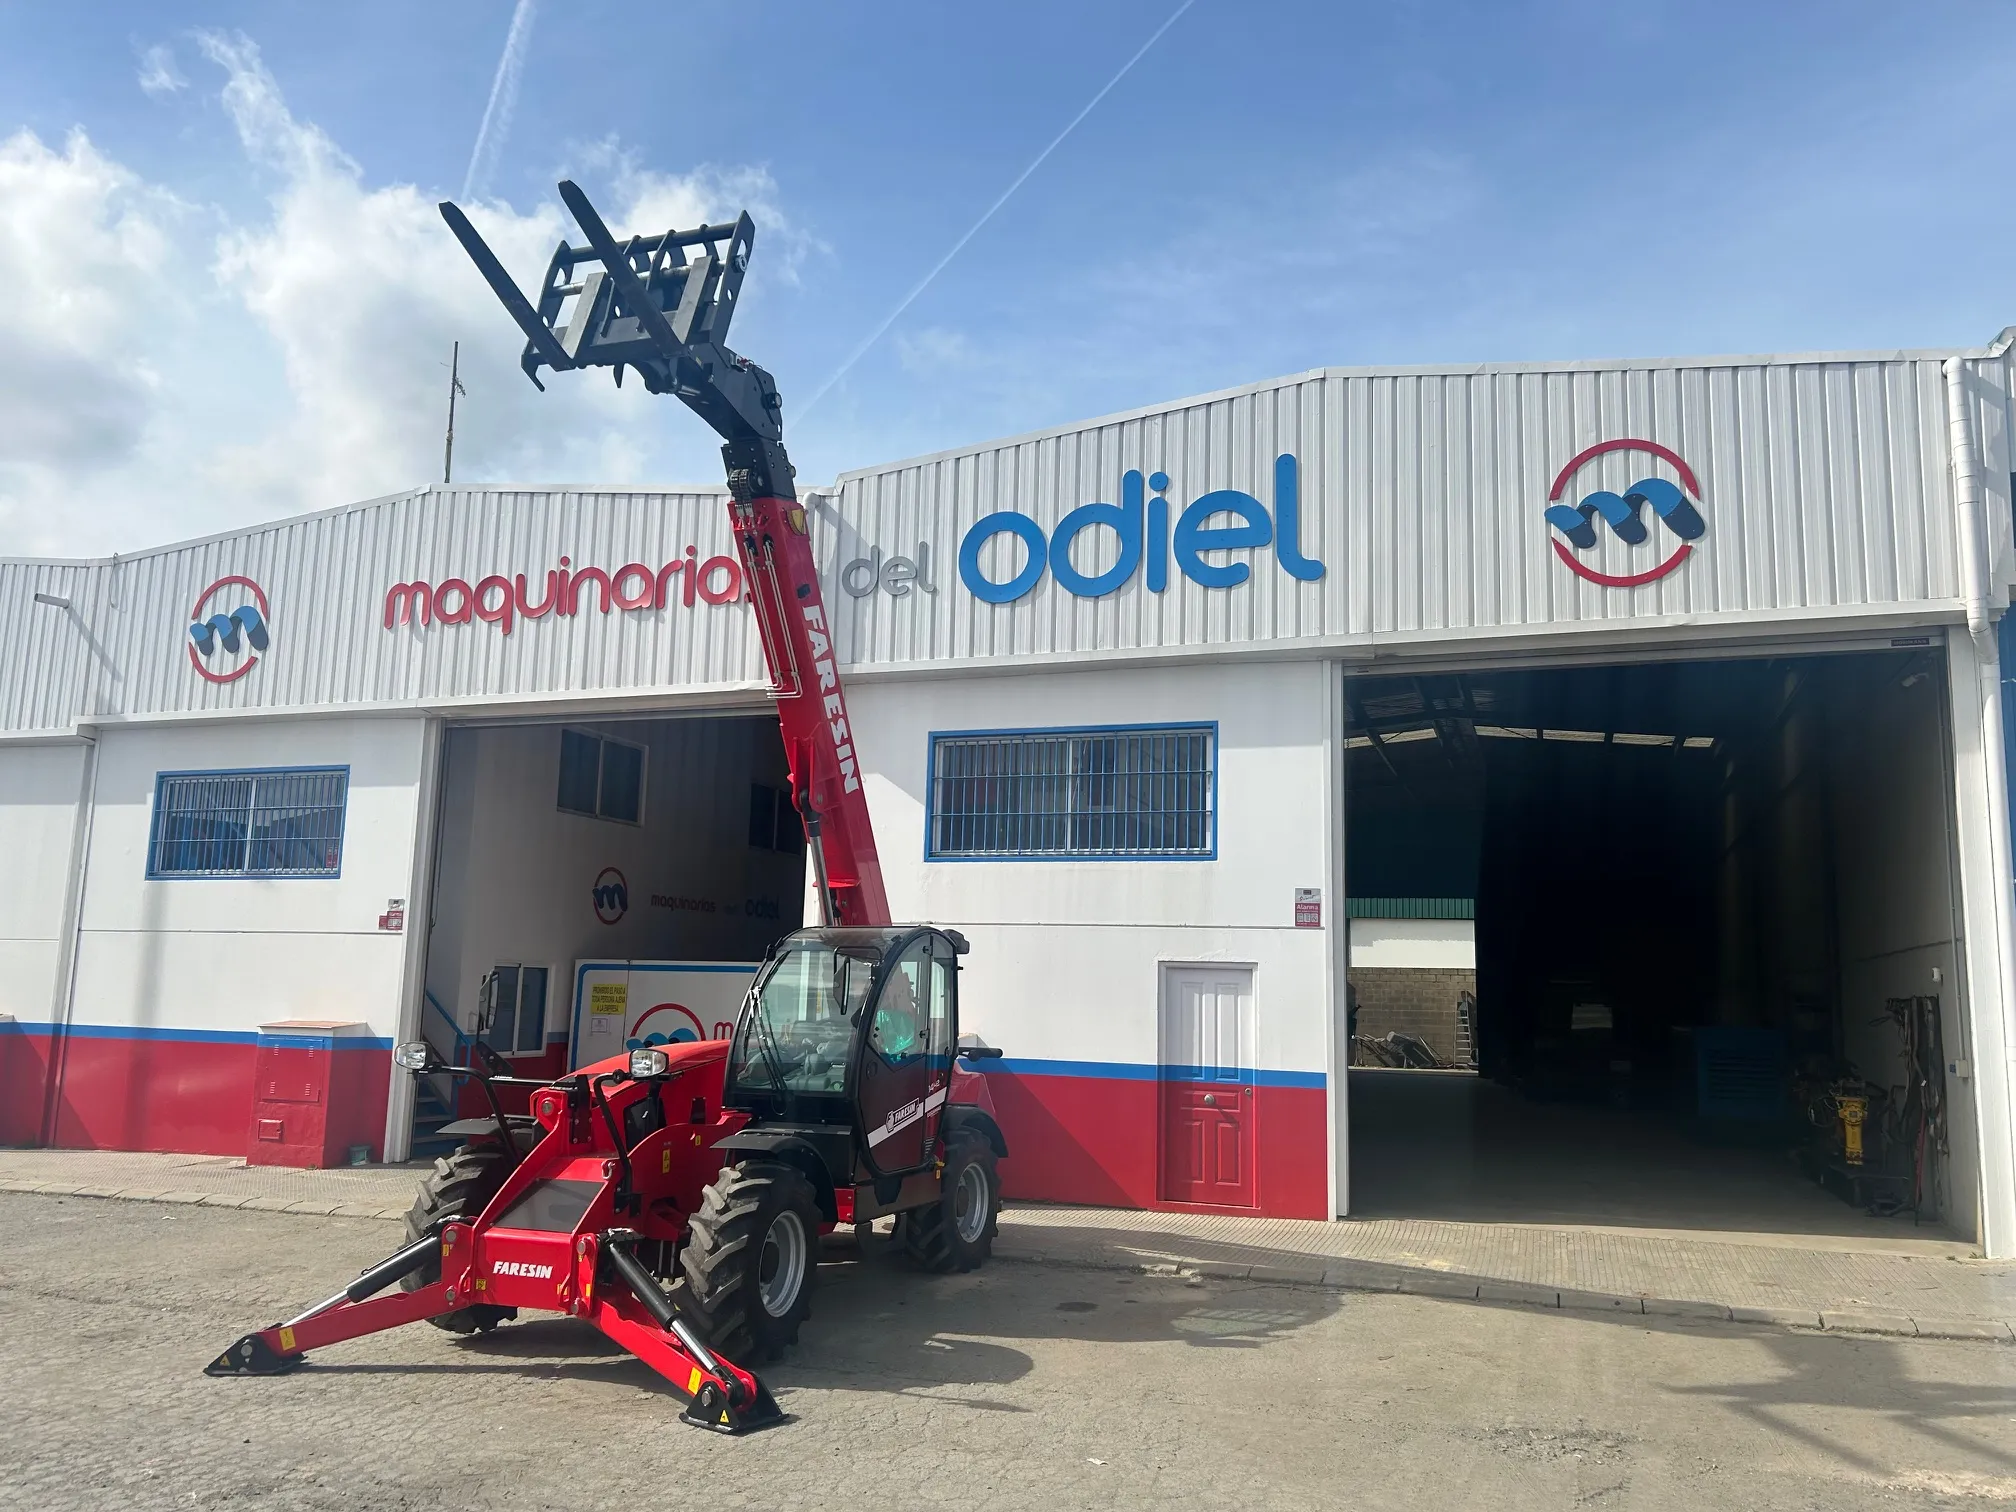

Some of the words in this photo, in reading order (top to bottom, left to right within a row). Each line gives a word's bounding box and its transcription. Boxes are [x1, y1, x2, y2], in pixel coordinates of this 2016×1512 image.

[385, 545, 753, 635] maquinaria
[841, 541, 939, 597] del
[958, 453, 1325, 605] odiel
[801, 605, 861, 795] FARESIN
[650, 894, 717, 913] maquinarias
[894, 1102, 917, 1123] FARESIN
[492, 1260, 554, 1279] FARESIN
